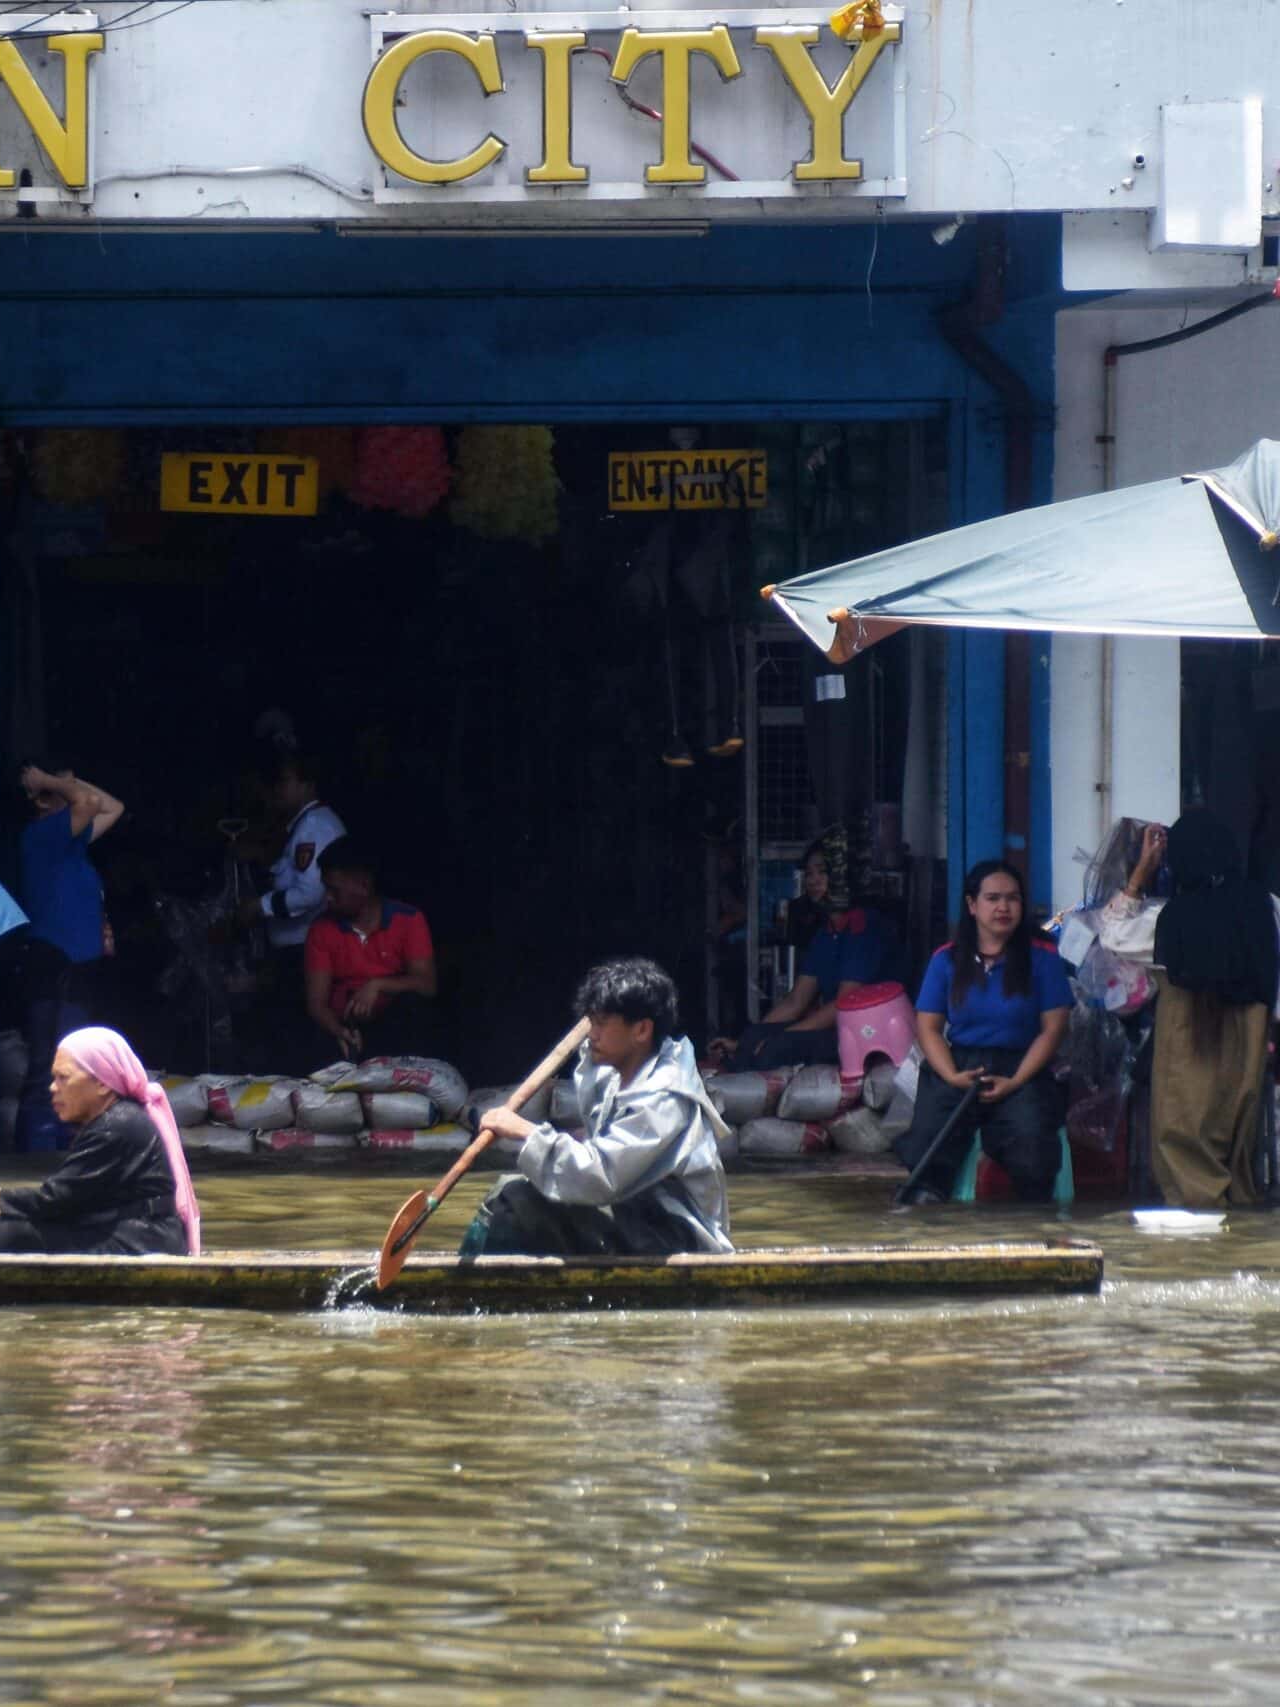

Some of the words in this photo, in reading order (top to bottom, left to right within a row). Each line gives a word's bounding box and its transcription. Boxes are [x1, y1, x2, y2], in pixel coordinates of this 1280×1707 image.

[362, 24, 903, 186] CITY
[189, 461, 305, 507] EXIT
[611, 457, 765, 503] ENTRANCE
